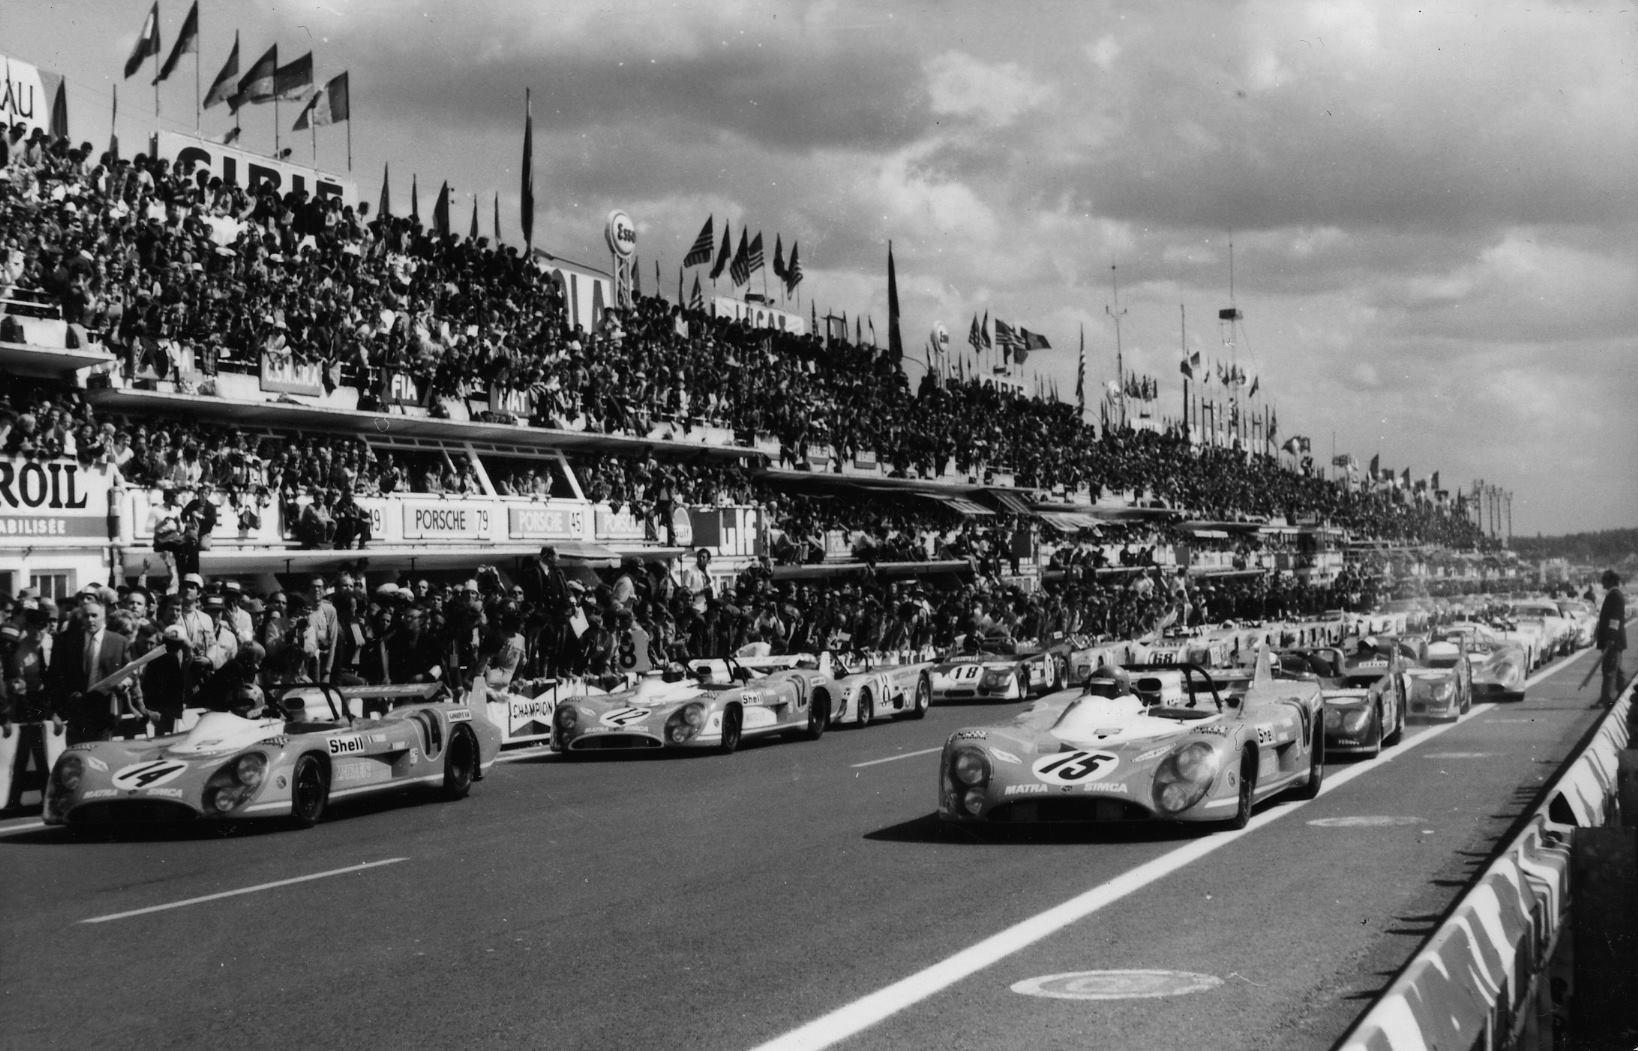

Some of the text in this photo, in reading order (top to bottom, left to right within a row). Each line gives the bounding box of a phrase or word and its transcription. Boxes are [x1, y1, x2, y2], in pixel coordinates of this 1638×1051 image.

[0, 79, 33, 119] AU
[415, 509, 489, 531] PORSCHE 79
[518, 511, 563, 532] PORSCHE
[955, 667, 979, 679] 18
[742, 694, 761, 705] Shel
[513, 701, 553, 719] CHAMPION
[606, 708, 649, 726] 12
[329, 736, 364, 754] Shell
[117, 760, 186, 788] 14
[1038, 751, 1116, 781] 15
[1004, 782, 1128, 795] MATRA SIMCA
